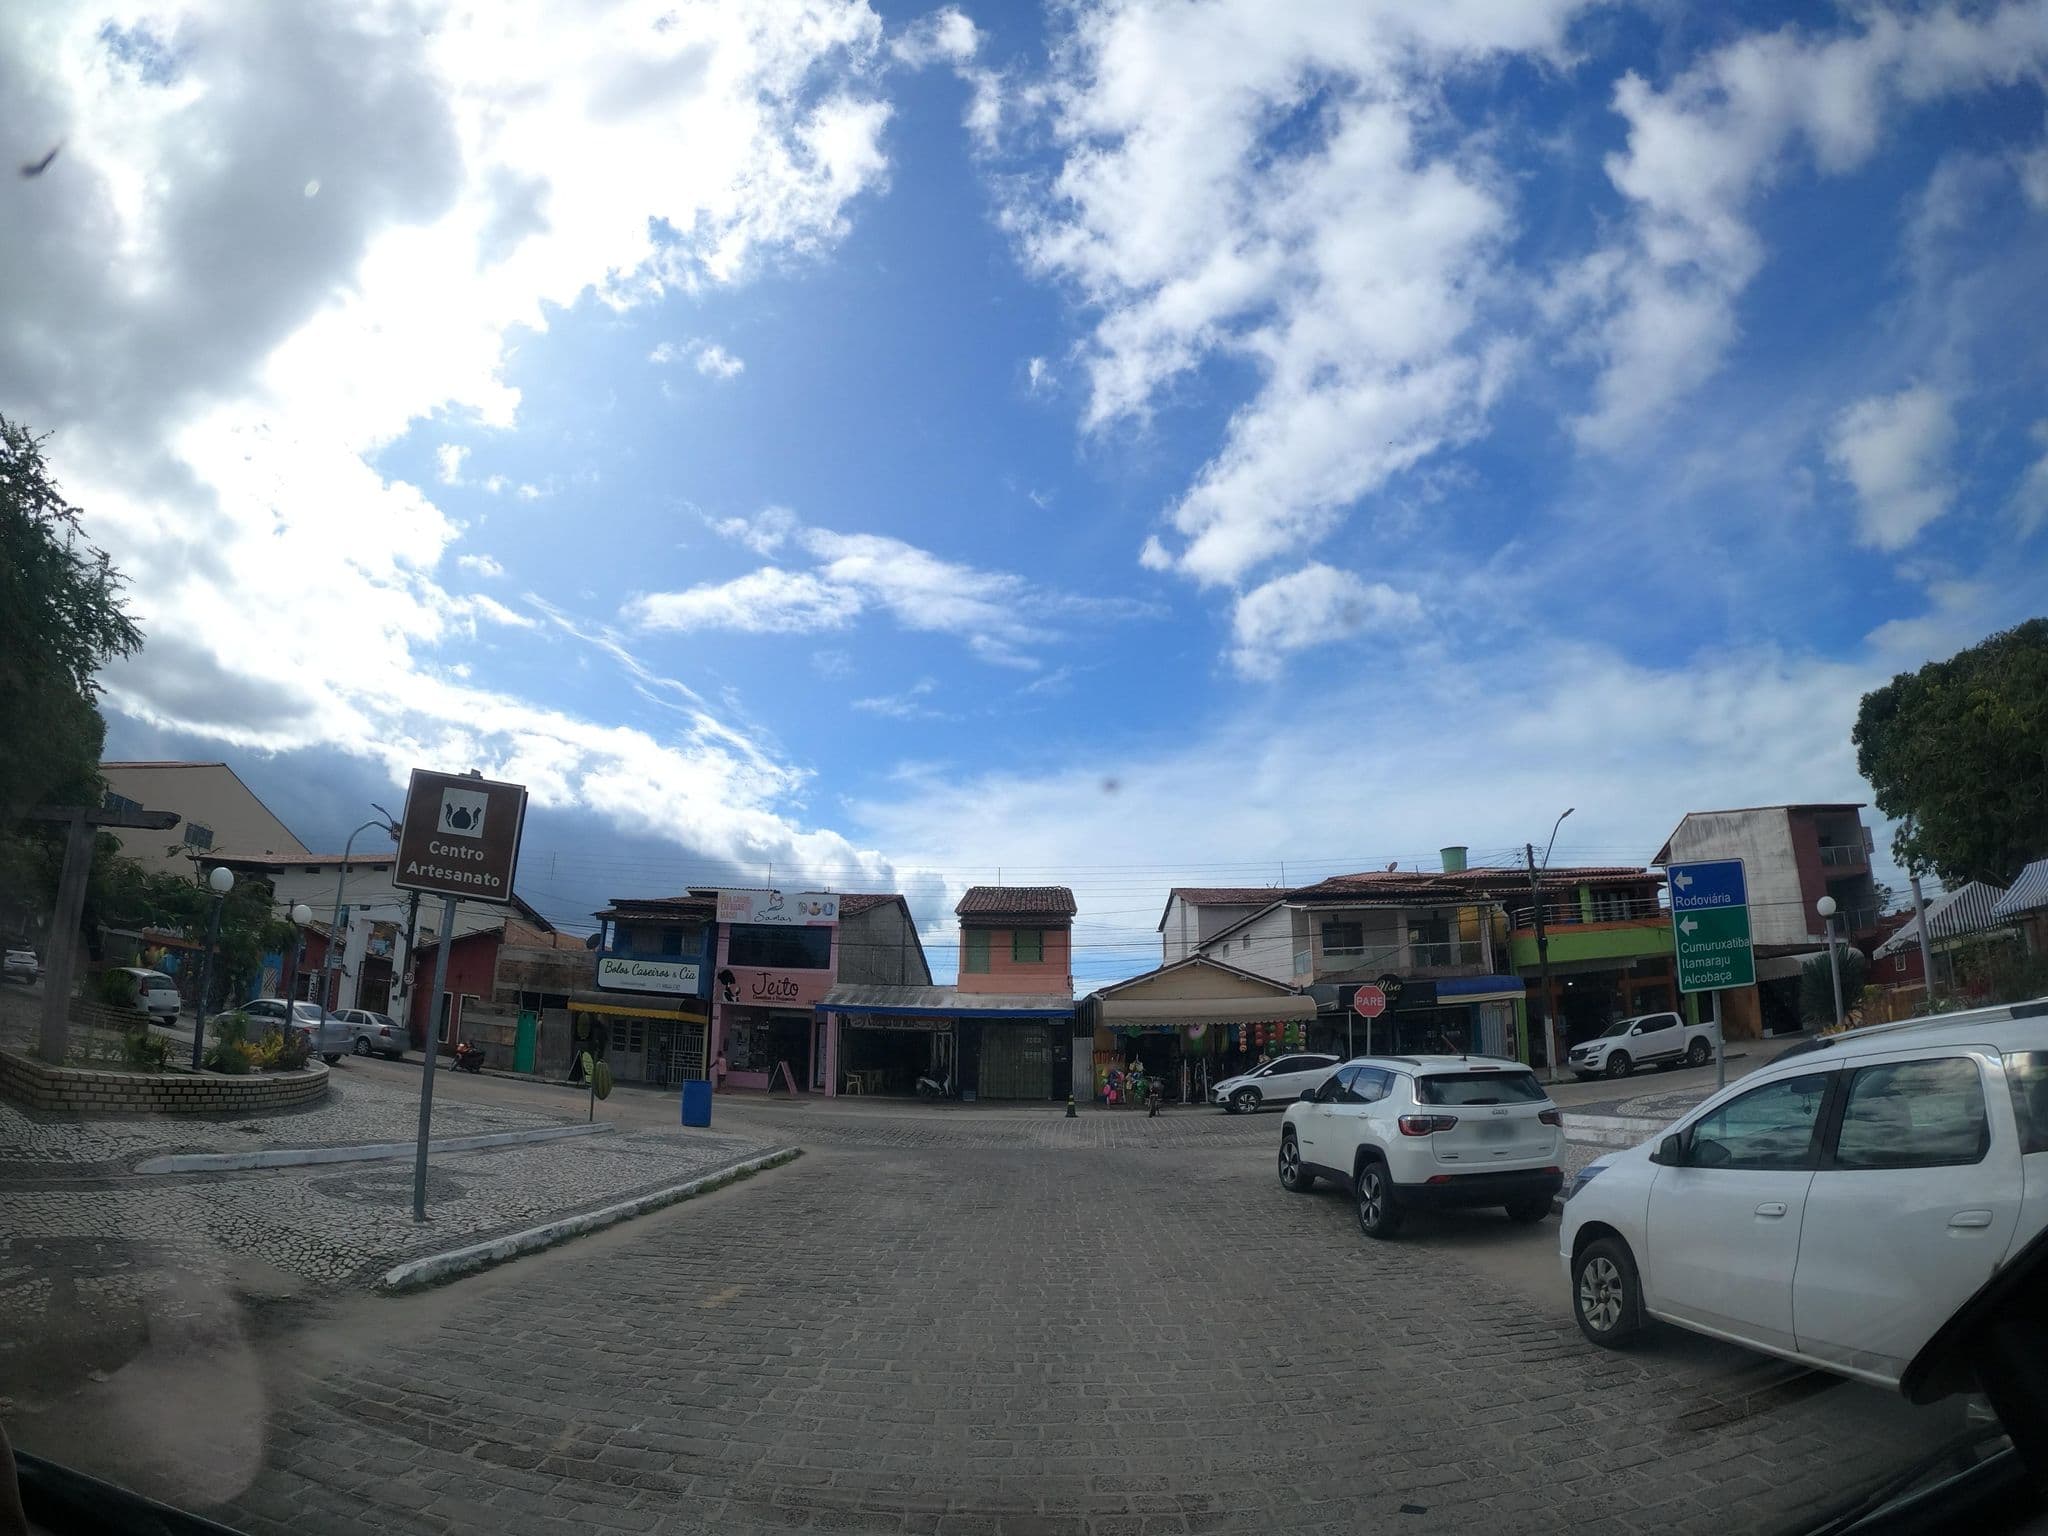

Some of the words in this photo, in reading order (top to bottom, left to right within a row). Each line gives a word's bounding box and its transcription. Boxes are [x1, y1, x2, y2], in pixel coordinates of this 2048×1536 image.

[429, 841, 484, 861] Centro
[406, 861, 500, 887] Artesanato
[1675, 893, 1731, 907] Rodoviária
[1681, 937, 1750, 953] Cumuruxatiba
[605, 961, 629, 975] Bolos
[632, 963, 669, 978] Caseiros
[679, 966, 697, 980] Cia
[1682, 956, 1731, 969] Itamaraju
[752, 972, 799, 996] Jeito
[1684, 970, 1732, 985] Alcobaça
[1356, 996, 1383, 1006] PARE
